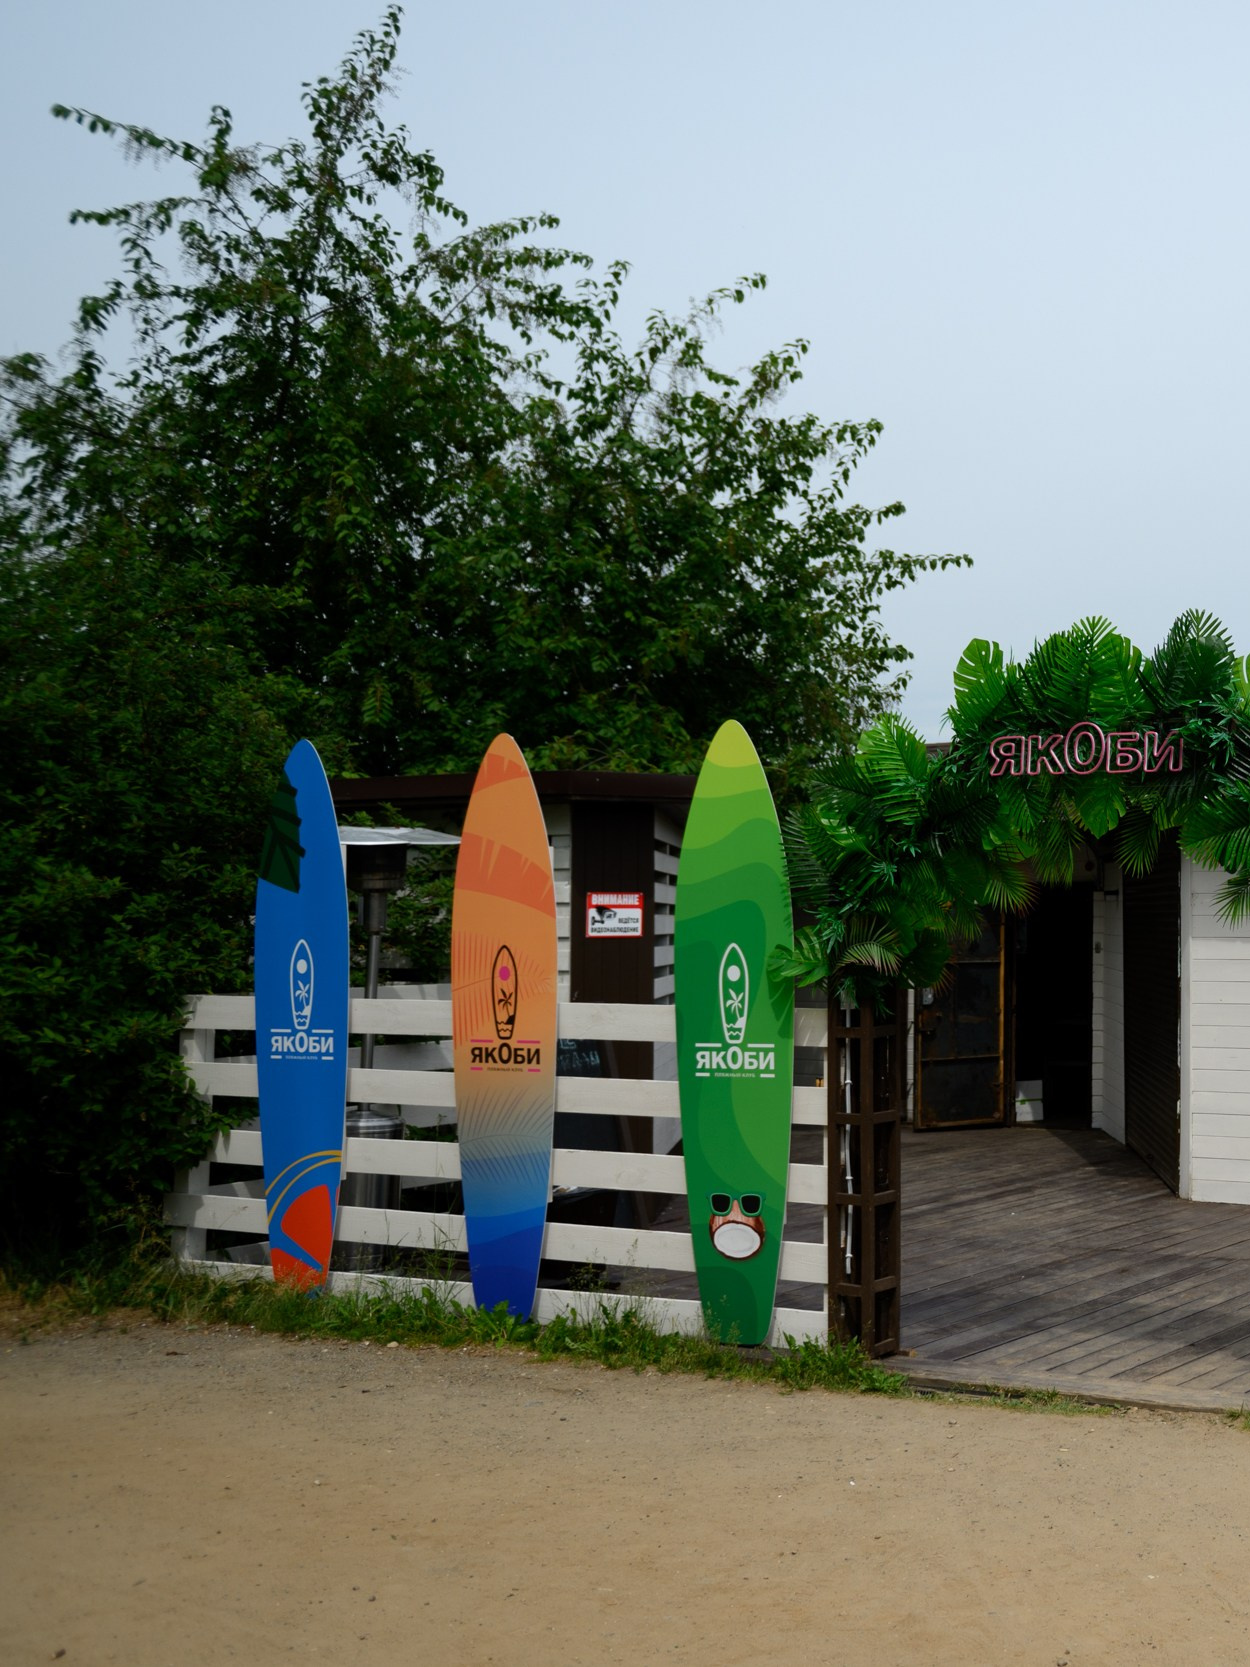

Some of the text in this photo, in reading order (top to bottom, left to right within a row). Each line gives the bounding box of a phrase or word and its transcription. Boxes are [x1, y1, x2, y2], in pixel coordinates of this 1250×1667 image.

[989, 721, 1184, 776] ЯКОБИ
[591, 894, 639, 905] ВНИМАНИЕ
[271, 1031, 334, 1053] ЯКОБИ
[471, 1042, 540, 1065] ЯКОБИ
[696, 1046, 775, 1070] ЯКОБИ
